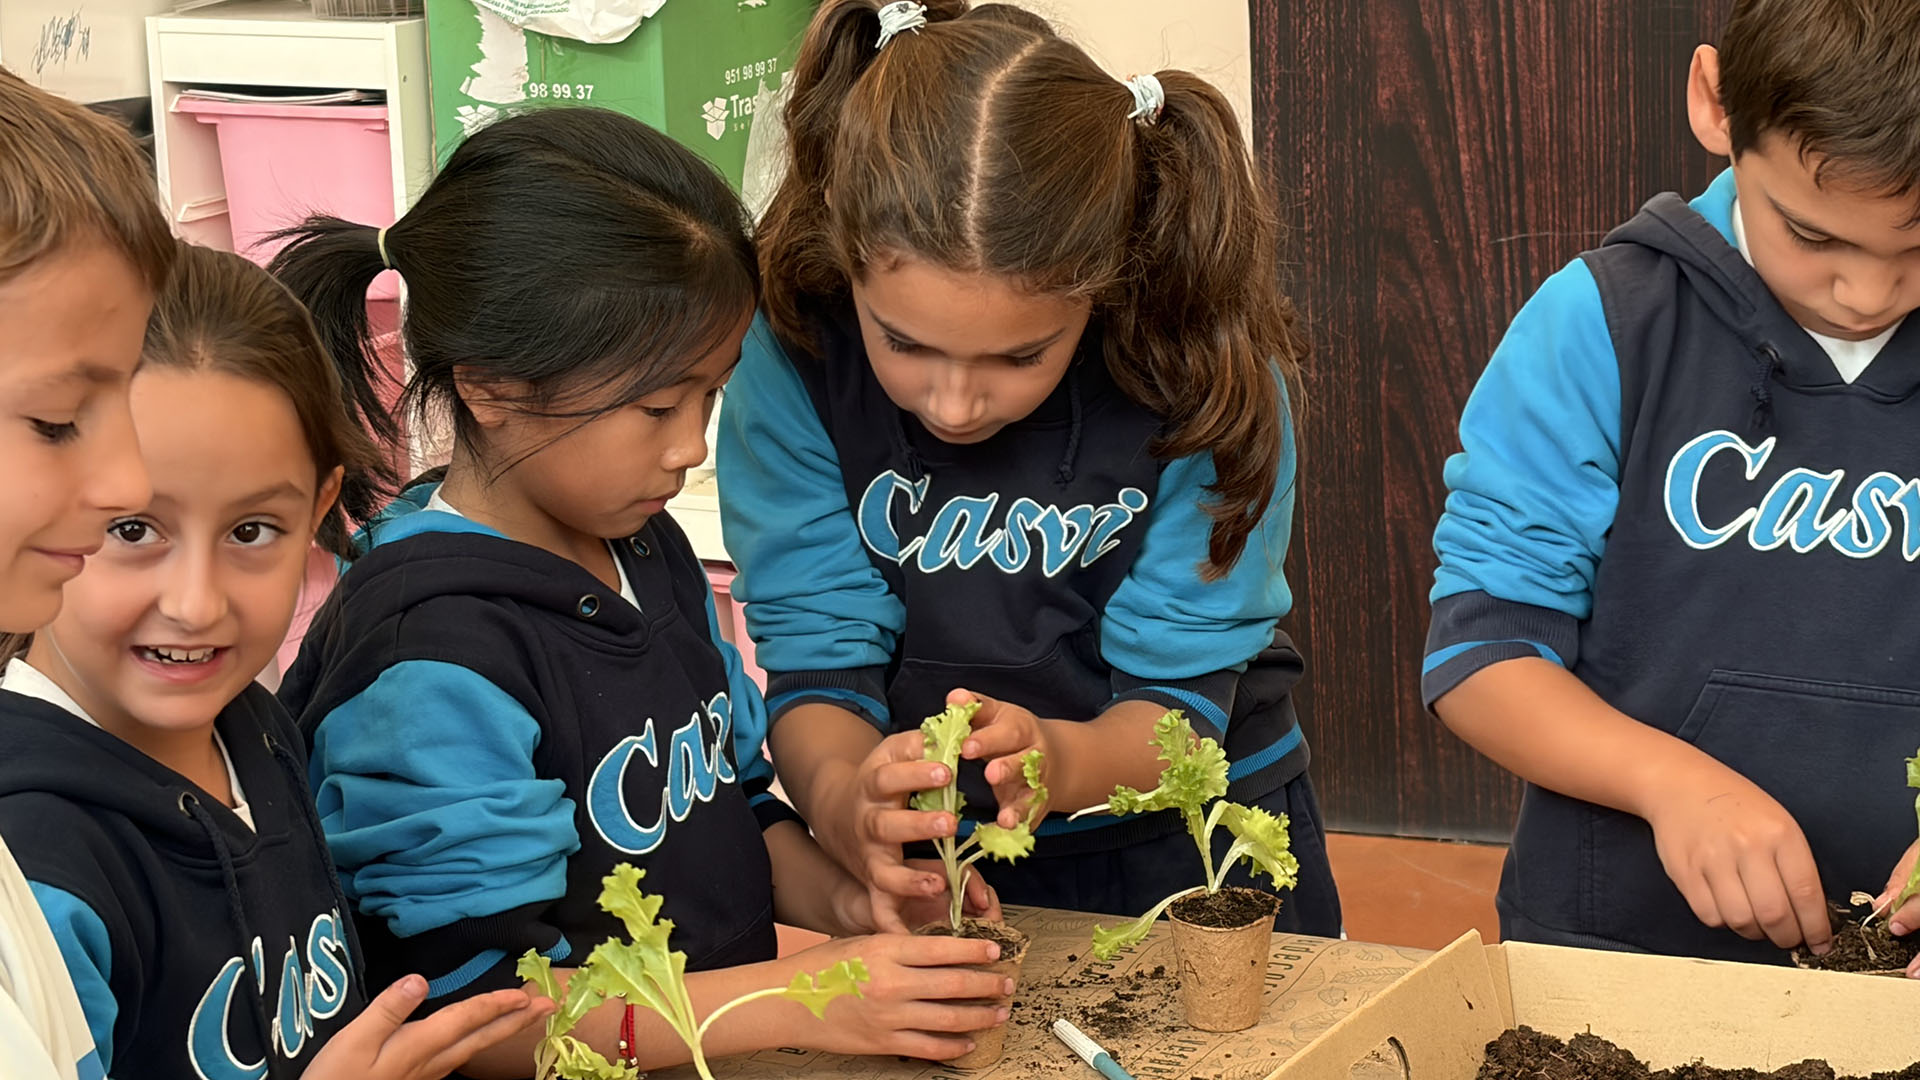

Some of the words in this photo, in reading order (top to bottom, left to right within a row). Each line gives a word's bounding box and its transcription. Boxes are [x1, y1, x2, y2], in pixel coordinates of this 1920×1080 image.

[724, 67, 741, 85] 951
[742, 64, 753, 80] 98
[755, 61, 766, 77] 99
[767, 57, 778, 74] 37
[529, 82, 548, 98] 98
[575, 84, 594, 100] 37
[858, 469, 1149, 578] Casvi
